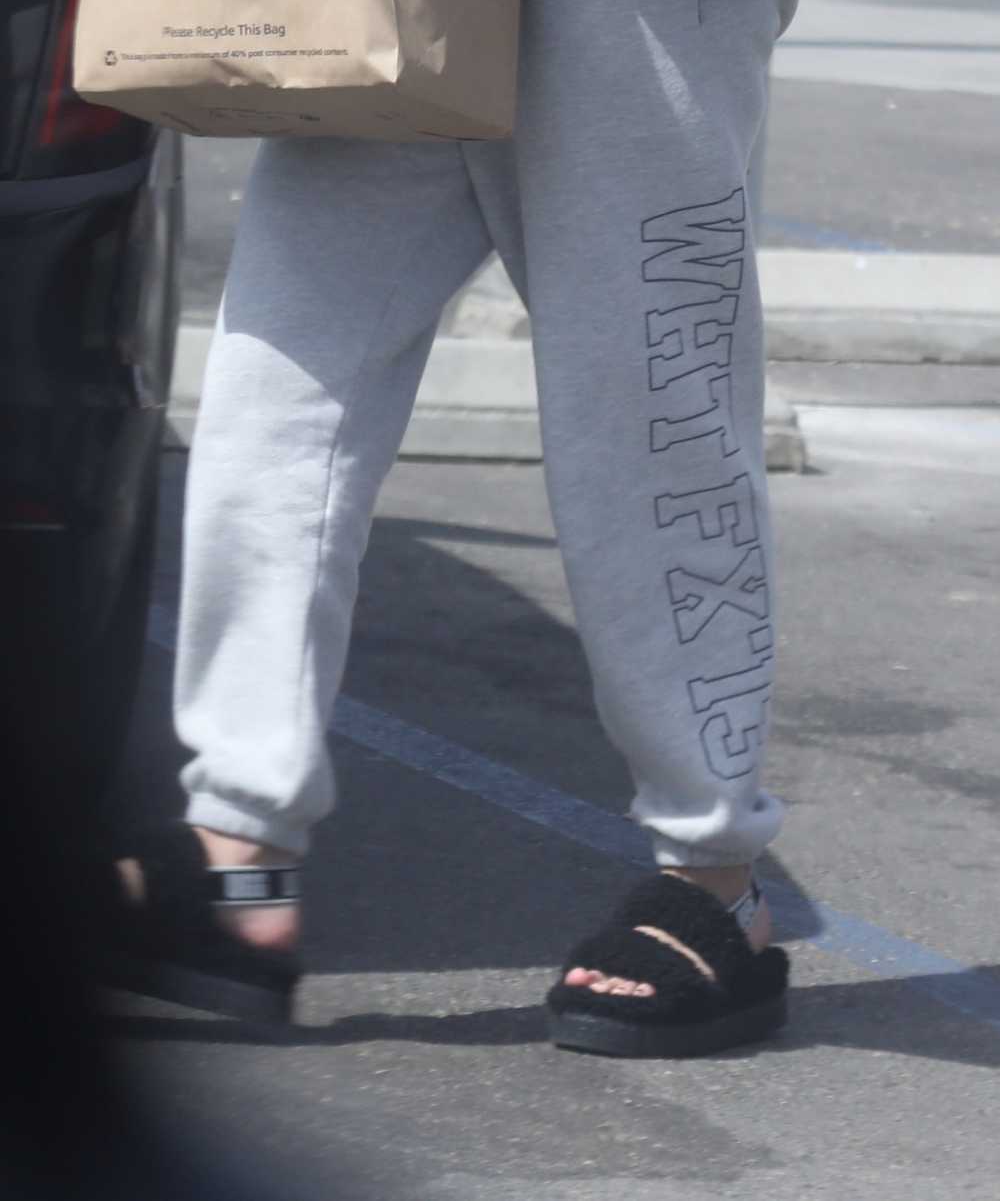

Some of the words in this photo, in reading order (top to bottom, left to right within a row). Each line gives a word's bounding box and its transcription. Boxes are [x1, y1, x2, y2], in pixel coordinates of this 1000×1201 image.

[196, 25, 236, 39] Recycle
[238, 24, 262, 36] This
[263, 23, 286, 38] Bag
